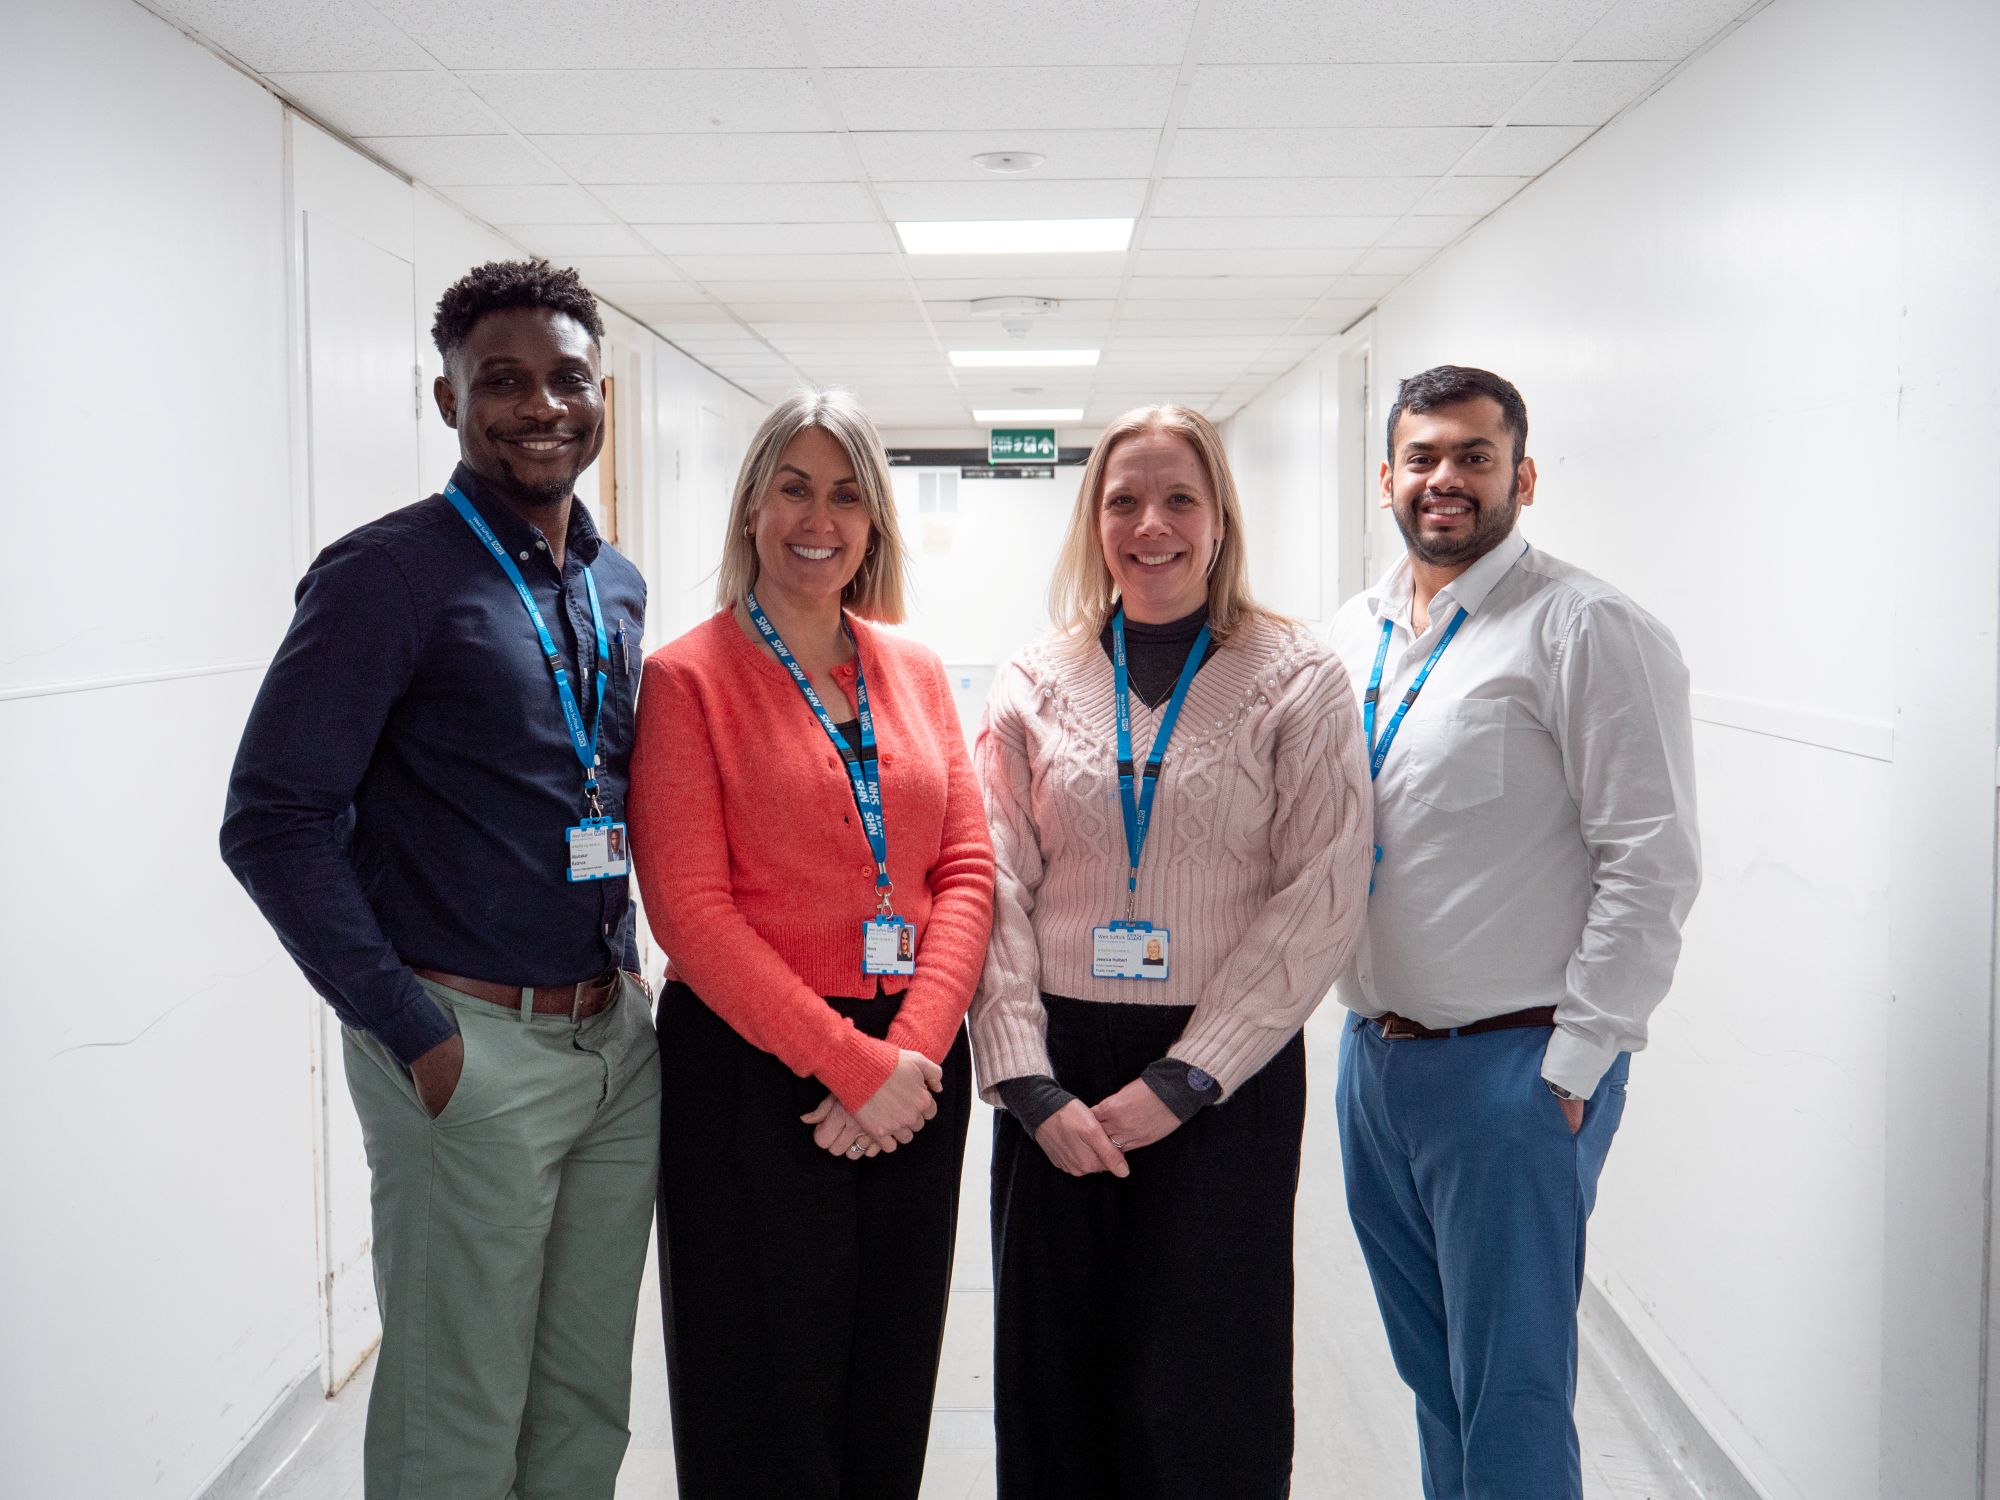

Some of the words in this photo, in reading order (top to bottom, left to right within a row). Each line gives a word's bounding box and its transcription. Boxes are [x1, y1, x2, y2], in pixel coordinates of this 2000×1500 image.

[472, 516, 483, 528] West
[480, 526, 493, 541] Suffolk
[490, 540, 505, 556] NHS
[747, 594, 758, 612] NHS
[756, 616, 774, 636] NHS
[771, 639, 790, 657] NHS
[788, 662, 806, 680] NHS
[804, 687, 821, 707] NHS
[858, 686, 866, 704] NHS
[820, 713, 838, 734] NHS
[860, 711, 872, 731] NHS
[576, 730, 587, 747] NHS
[855, 780, 869, 803] NHS
[868, 782, 880, 805] NHS
[864, 812, 878, 836] NHS
[1137, 810, 1146, 825] NHS
